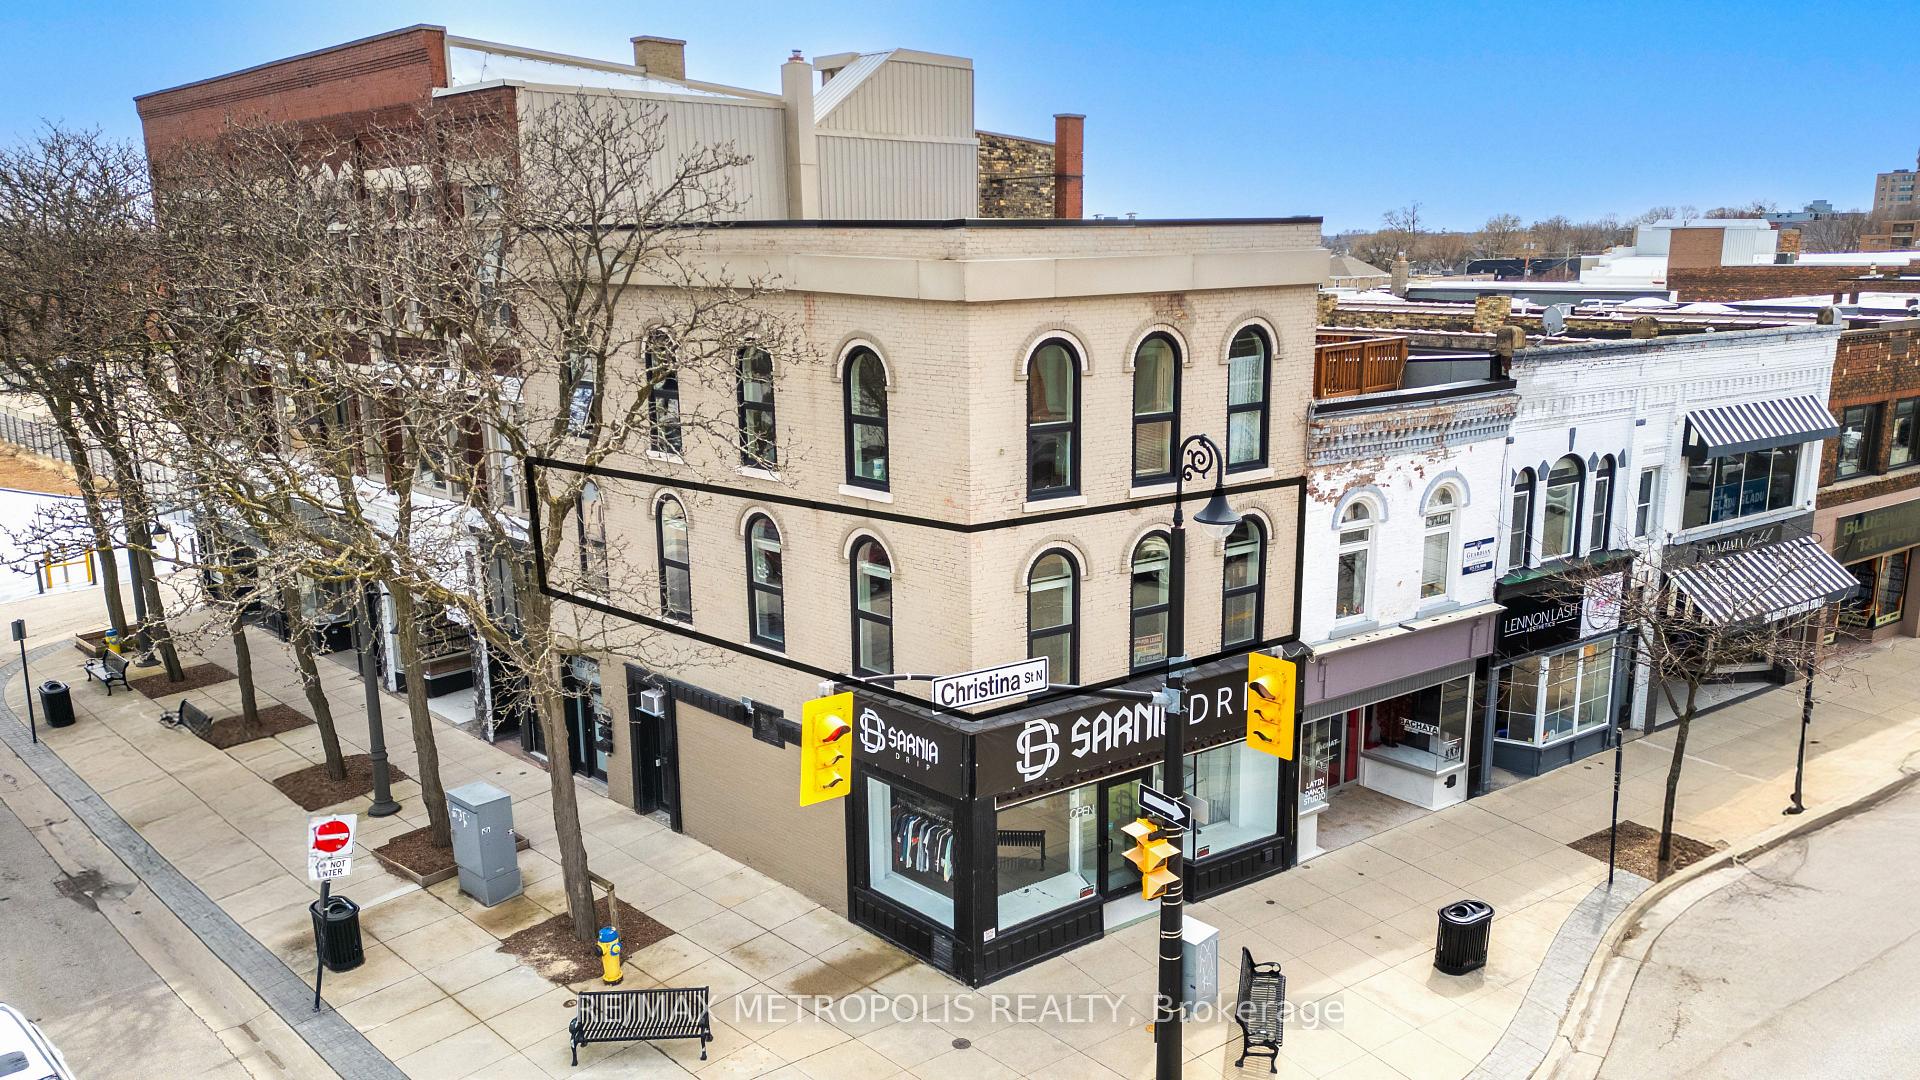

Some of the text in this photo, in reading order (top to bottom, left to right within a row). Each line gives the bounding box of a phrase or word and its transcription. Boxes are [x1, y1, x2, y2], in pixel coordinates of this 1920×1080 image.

[1504, 610, 1550, 633] LENNON
[941, 669, 1043, 705] Christina St N
[888, 726, 939, 765] SARNIA
[895, 752, 931, 771] DRIP
[1305, 776, 1325, 790] LATIN
[1303, 792, 1326, 806] STUDIO
[1304, 785, 1325, 798] DANCE
[1069, 804, 1095, 819] OPEN
[330, 860, 346, 869] NOT
